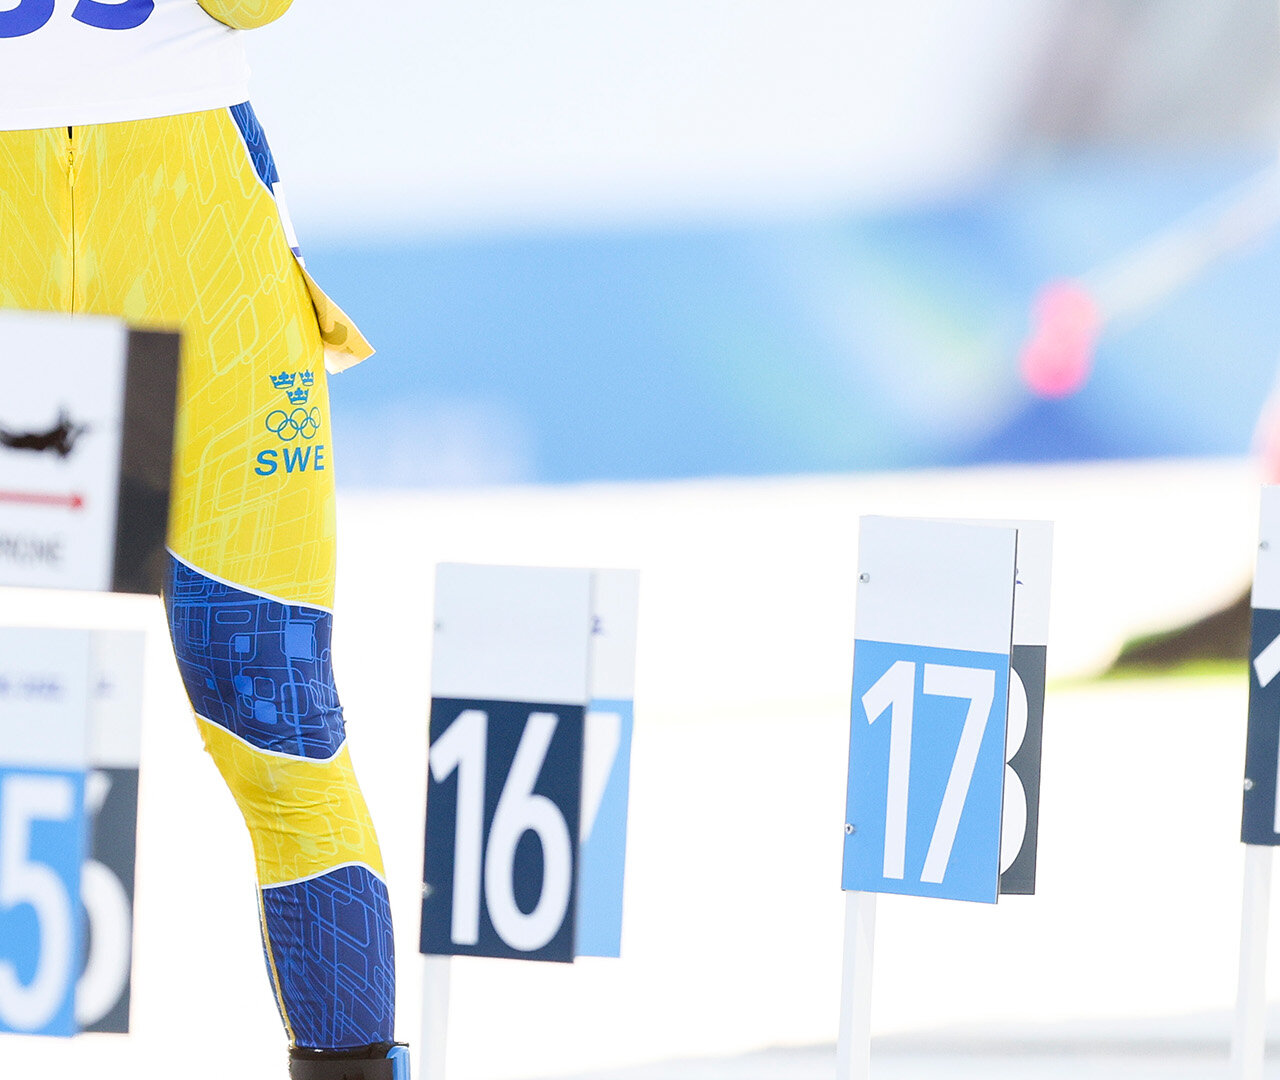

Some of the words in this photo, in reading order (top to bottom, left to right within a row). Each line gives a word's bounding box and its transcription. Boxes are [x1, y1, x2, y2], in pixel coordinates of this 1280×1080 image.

[254, 445, 325, 476] SWE
[428, 709, 572, 951] 16
[861, 660, 996, 884] 17
